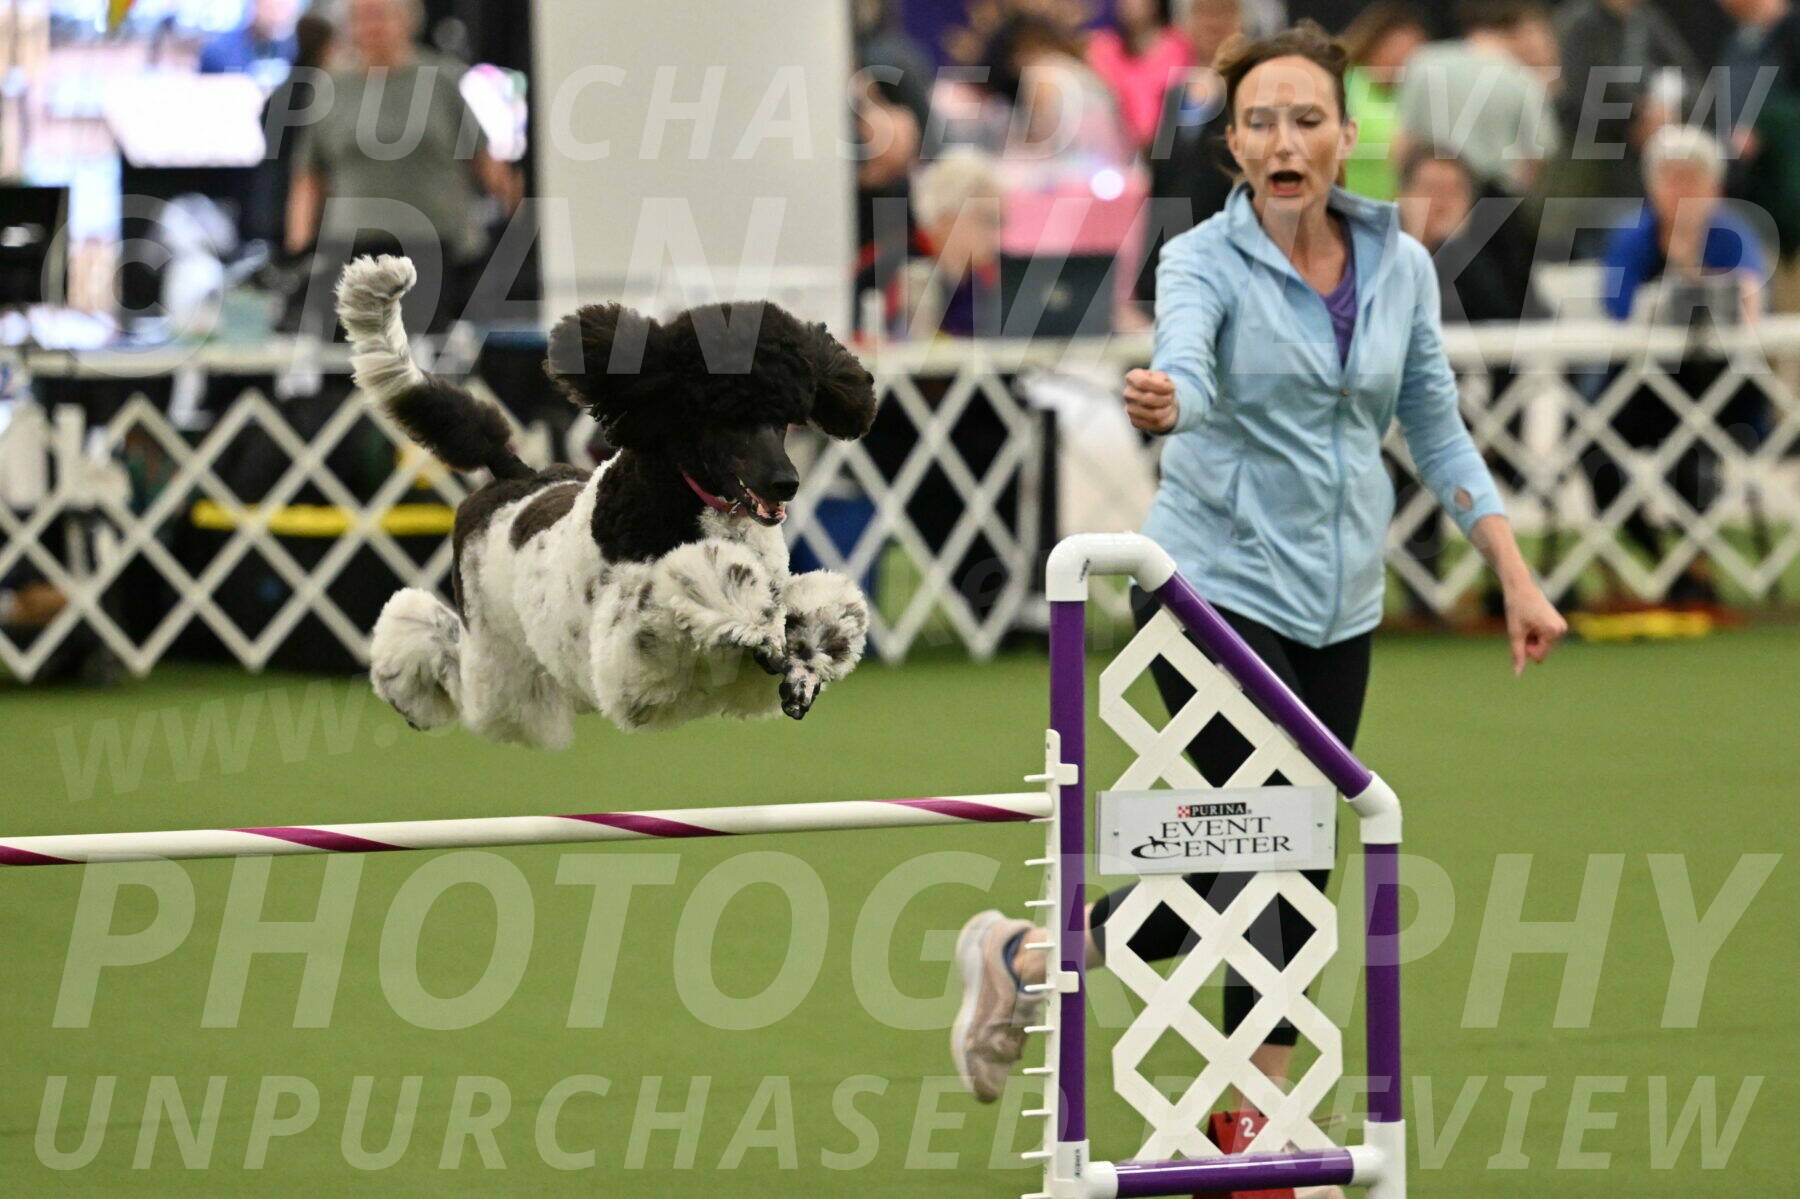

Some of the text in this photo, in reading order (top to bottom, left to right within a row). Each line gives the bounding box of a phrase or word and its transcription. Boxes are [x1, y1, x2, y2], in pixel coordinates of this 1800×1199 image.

[1192, 803, 1245, 816] PURINA
[1161, 816, 1271, 839] EVENT
[1131, 835, 1293, 860] CENTER
[1241, 1116, 1256, 1138] 2
